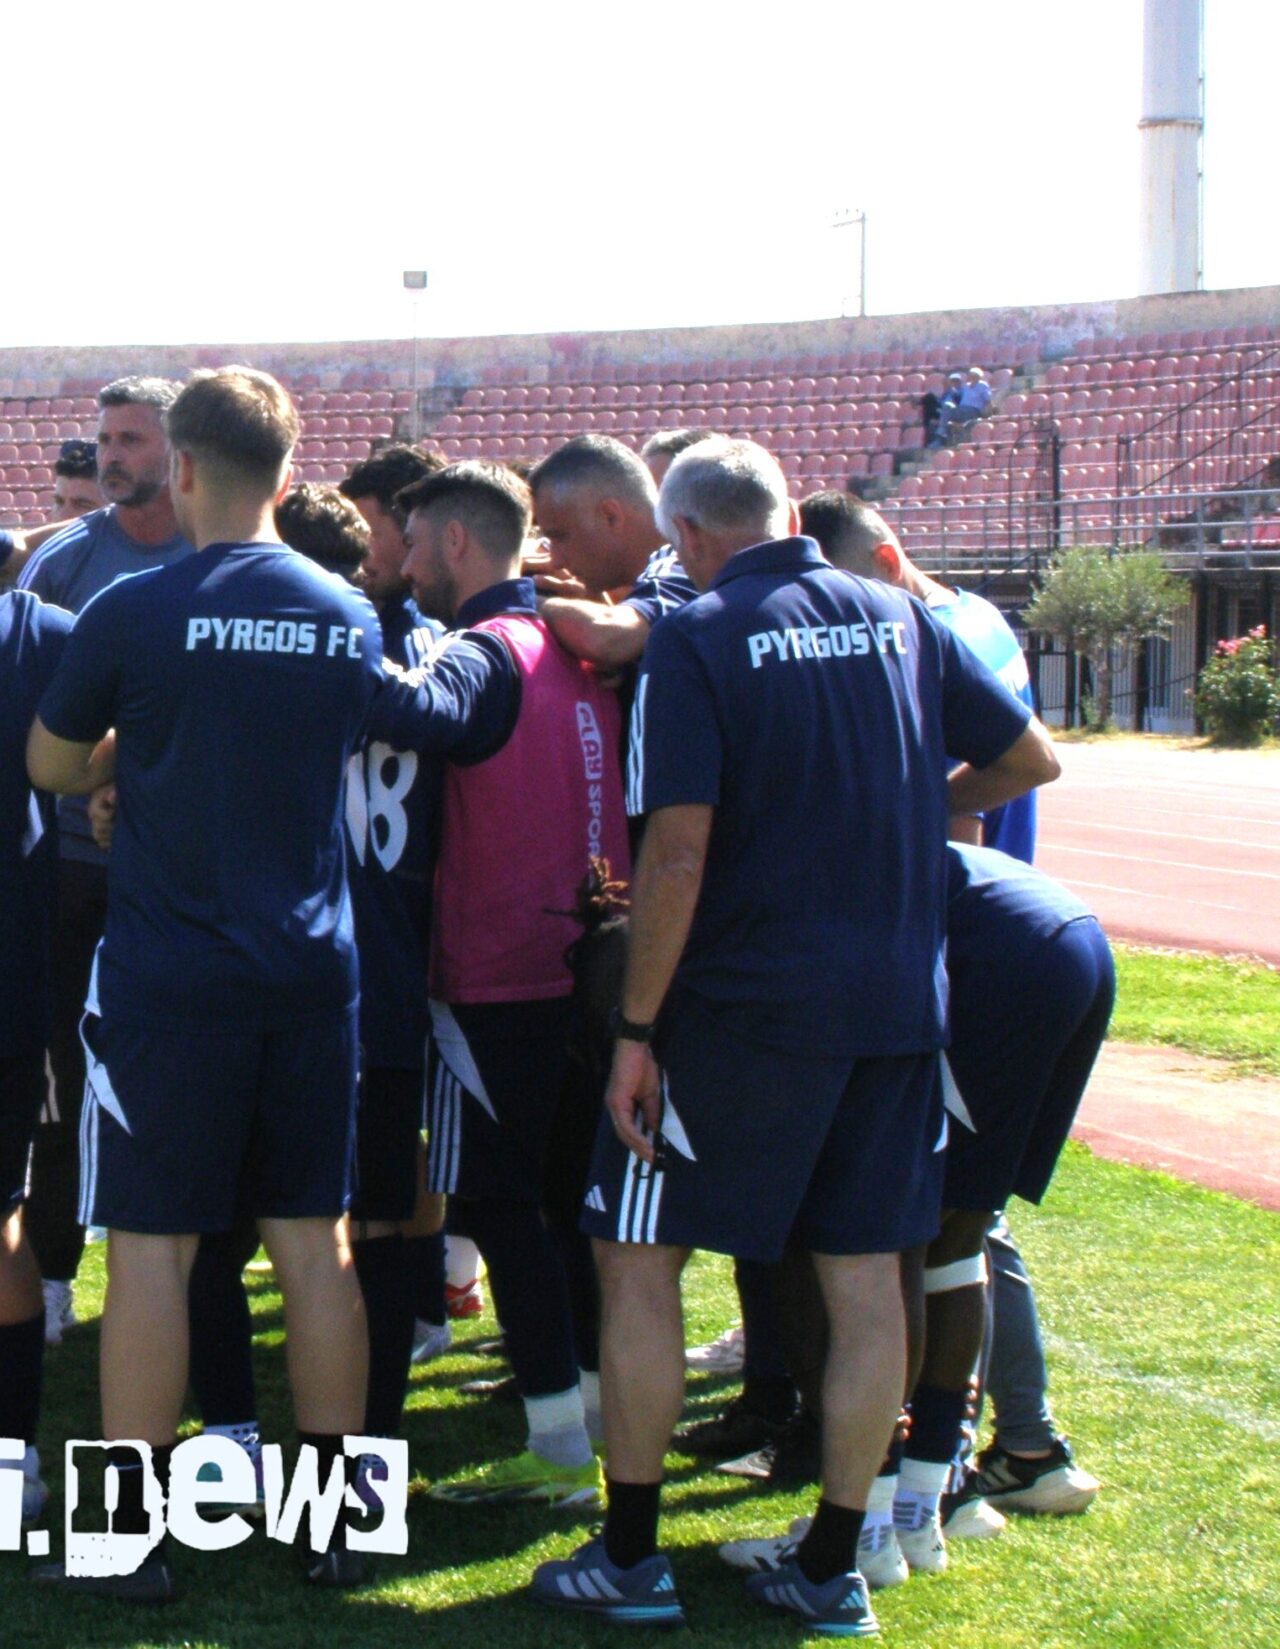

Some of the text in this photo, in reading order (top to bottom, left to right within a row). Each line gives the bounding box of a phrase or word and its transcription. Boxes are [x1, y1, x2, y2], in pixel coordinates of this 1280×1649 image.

[186, 618, 363, 659] PYRGOS FC
[747, 621, 907, 668] PYRGOS FC
[344, 740, 419, 873] 18
